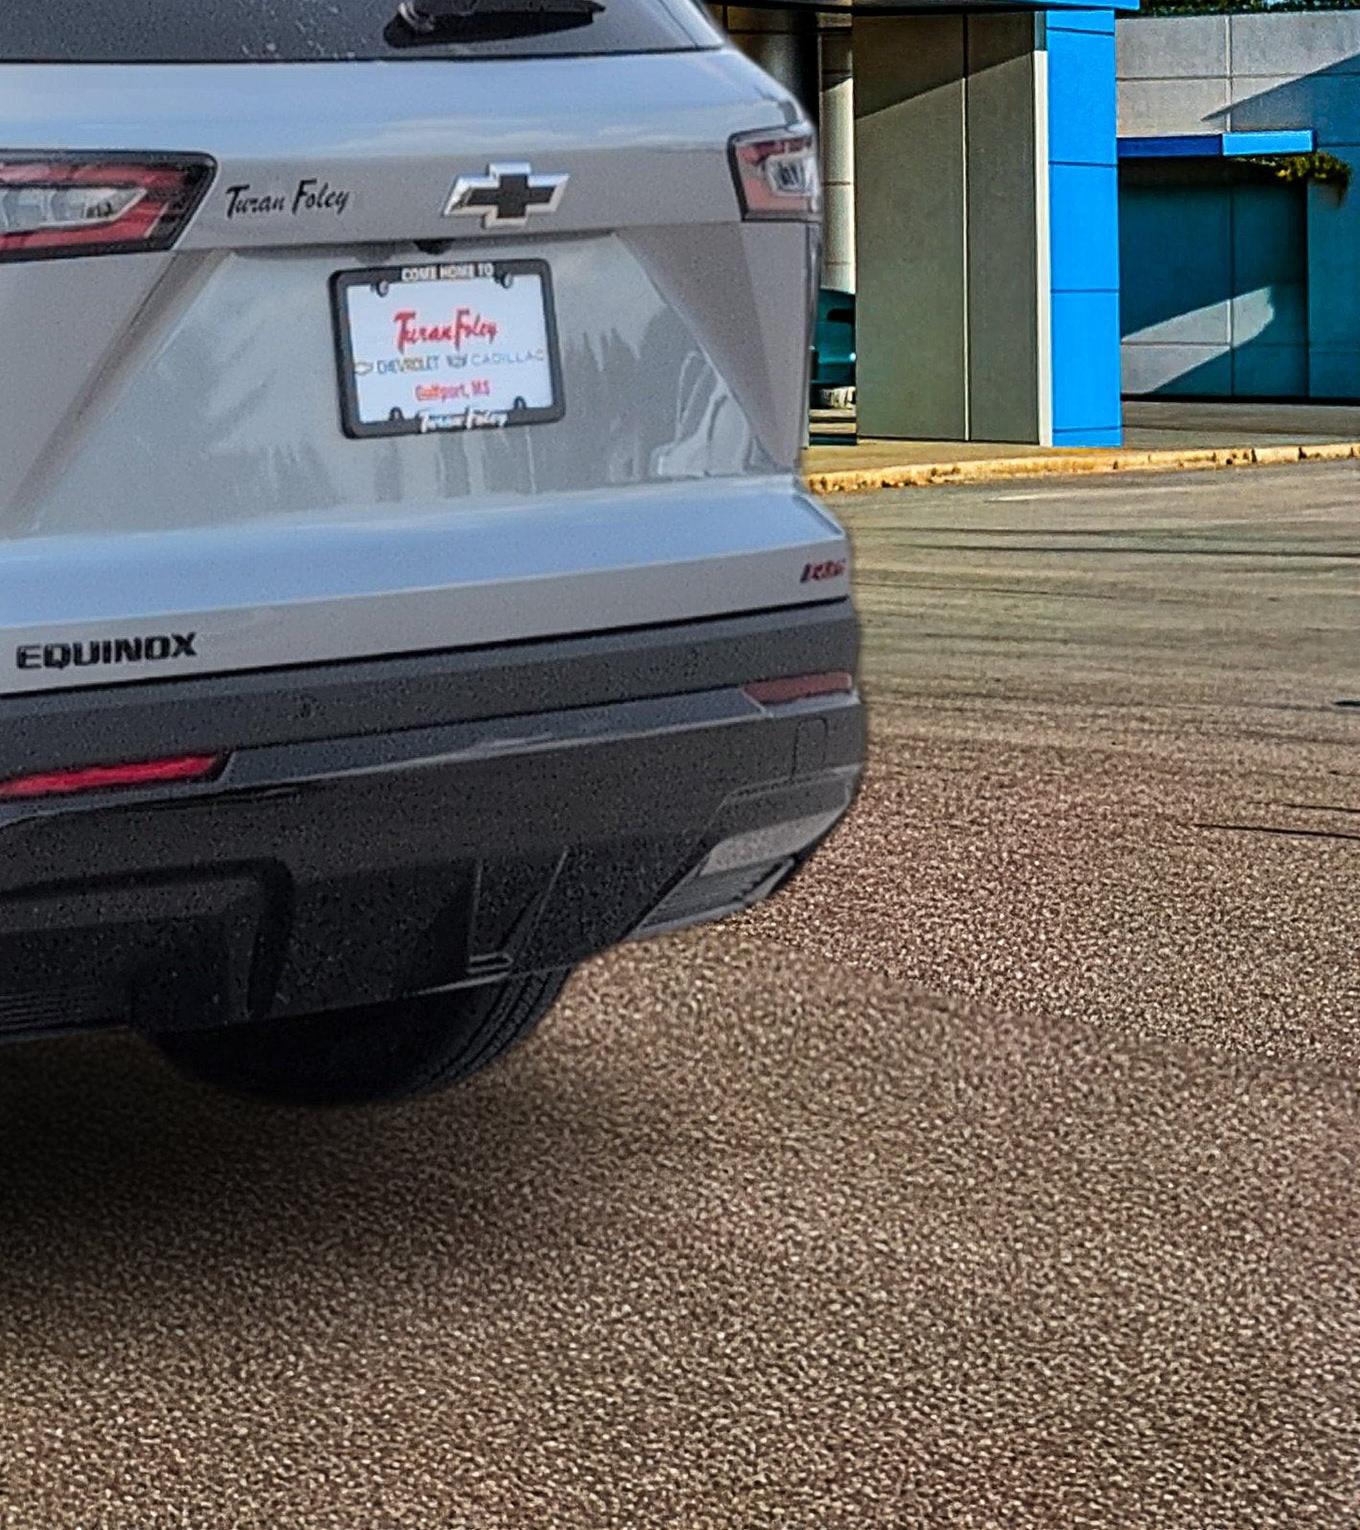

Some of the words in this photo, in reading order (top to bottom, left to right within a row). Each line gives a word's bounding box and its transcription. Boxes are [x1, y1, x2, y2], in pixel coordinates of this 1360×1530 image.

[224, 183, 285, 220] Turan
[291, 178, 351, 216] Foley
[478, 263, 494, 277] TO
[15, 631, 197, 670] EQUINOX
